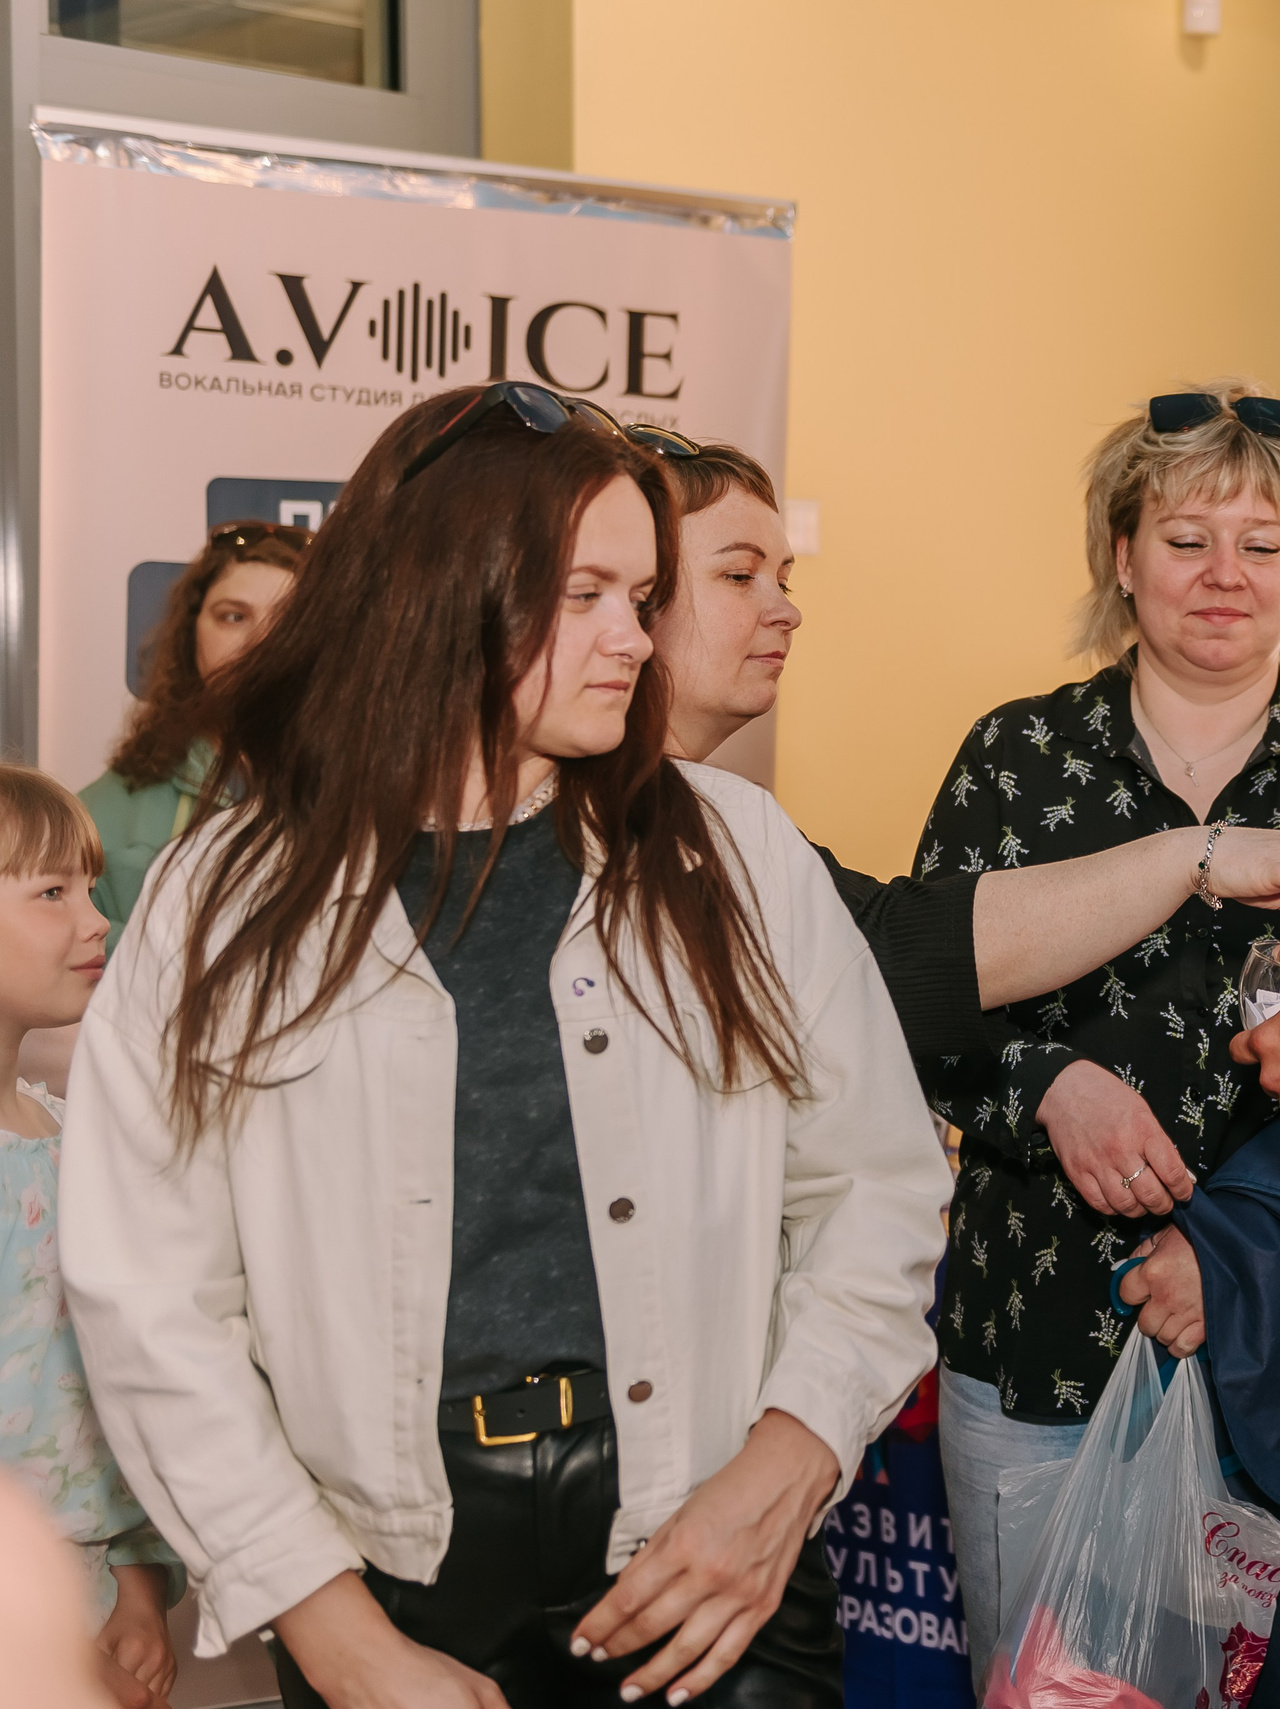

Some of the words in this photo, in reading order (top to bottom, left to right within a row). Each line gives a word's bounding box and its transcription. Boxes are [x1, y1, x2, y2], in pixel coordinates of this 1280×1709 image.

[158, 371, 303, 398] ВОКАЛЬНАЯ
[309, 383, 402, 406] СТУДИЯ
[826, 1544, 959, 1603] УЛЬТУ
[1218, 1571, 1240, 1588] за
[836, 1594, 969, 1656] РАЗОВА
